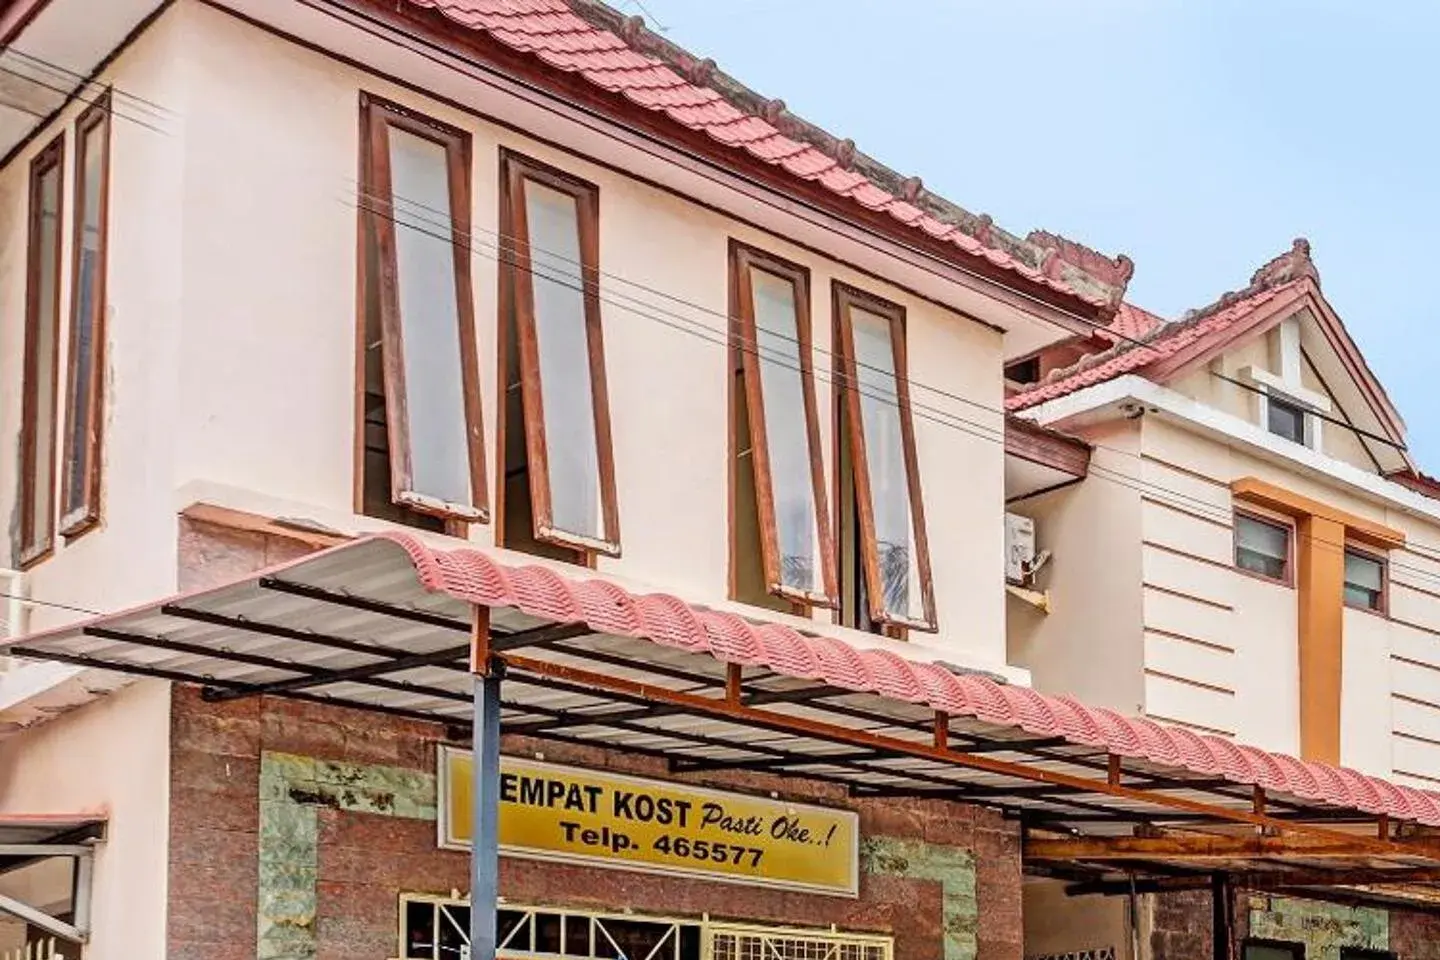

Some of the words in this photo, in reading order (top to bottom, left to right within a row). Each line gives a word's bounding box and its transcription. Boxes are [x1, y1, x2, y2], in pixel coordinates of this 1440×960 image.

[500, 773, 603, 813] EMPAT
[613, 790, 692, 828] KOST
[700, 802, 763, 836] Pasti
[770, 815, 838, 847] Oke..!
[559, 821, 639, 853] Telp.
[653, 834, 764, 867] 465577
